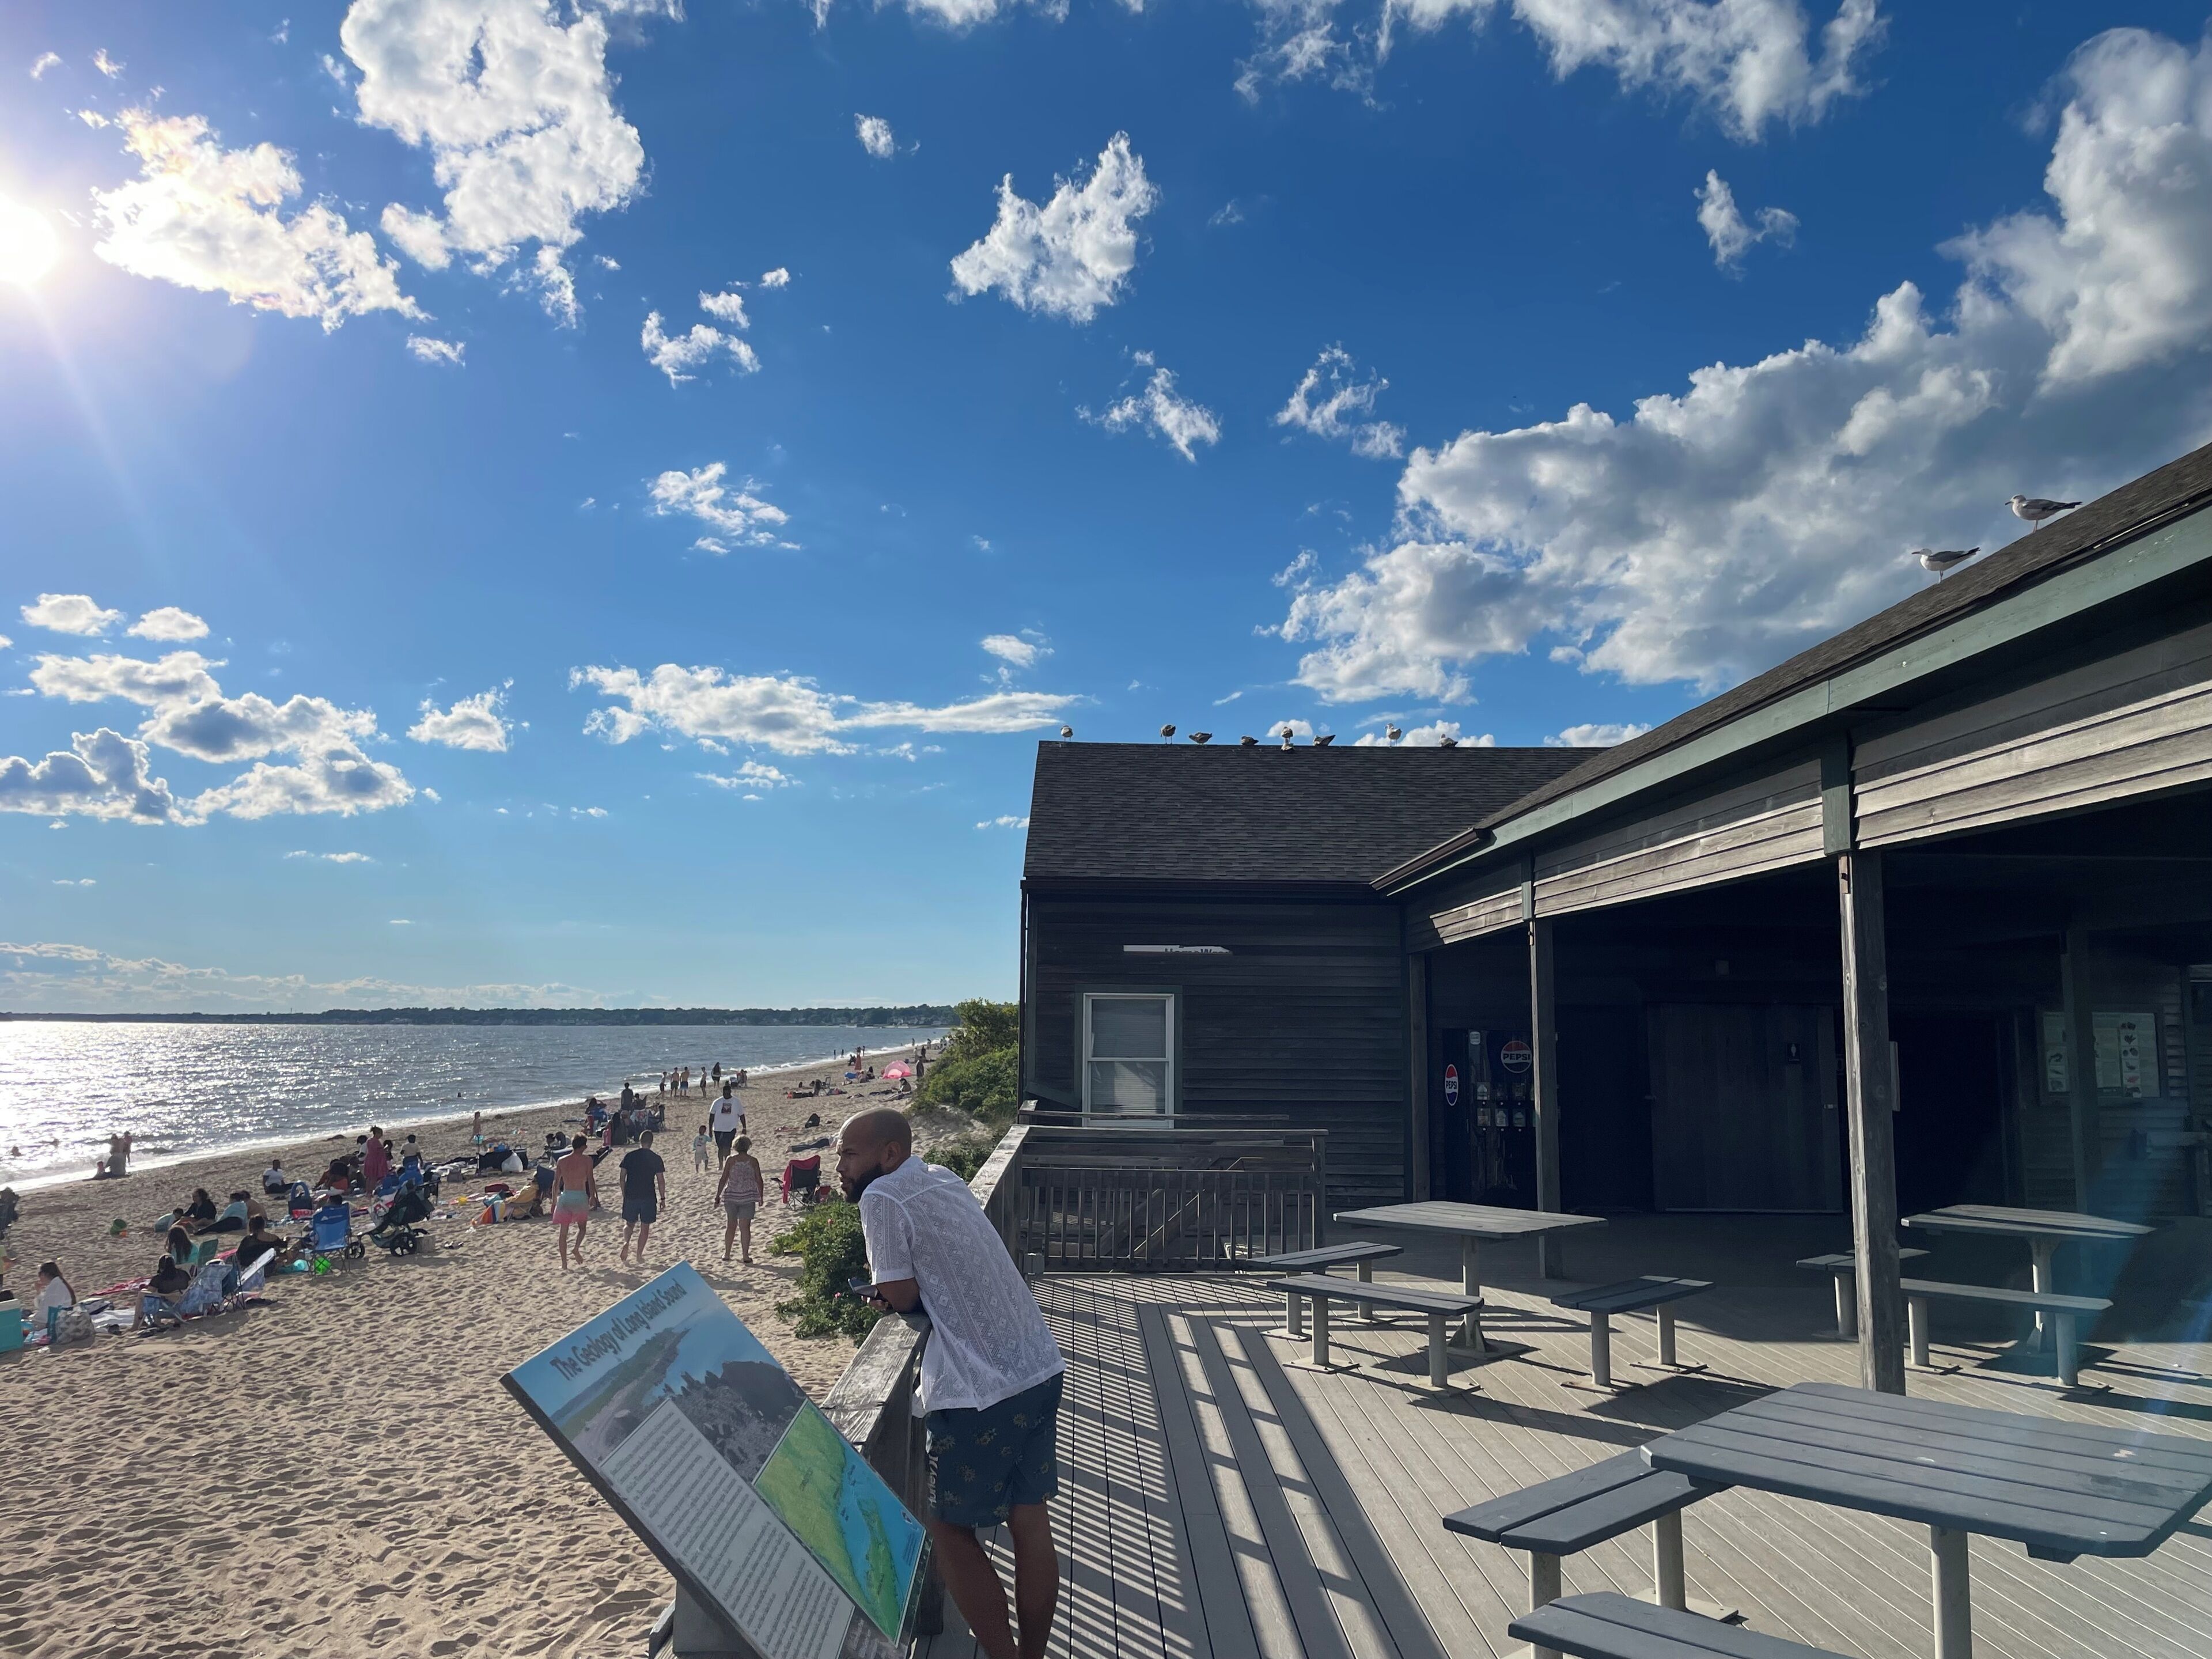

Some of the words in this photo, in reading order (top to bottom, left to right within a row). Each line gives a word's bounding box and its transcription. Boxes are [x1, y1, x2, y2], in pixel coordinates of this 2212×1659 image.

[1446, 1080, 1457, 1090] PEPSI
[657, 1278, 687, 1306] Sound
[635, 1291, 666, 1321] Island
[611, 1317, 628, 1340] of
[615, 1312, 650, 1334] Long
[571, 1335, 622, 1366] Geology
[550, 1356, 583, 1381] The
[927, 1467, 937, 1508] Hurley
